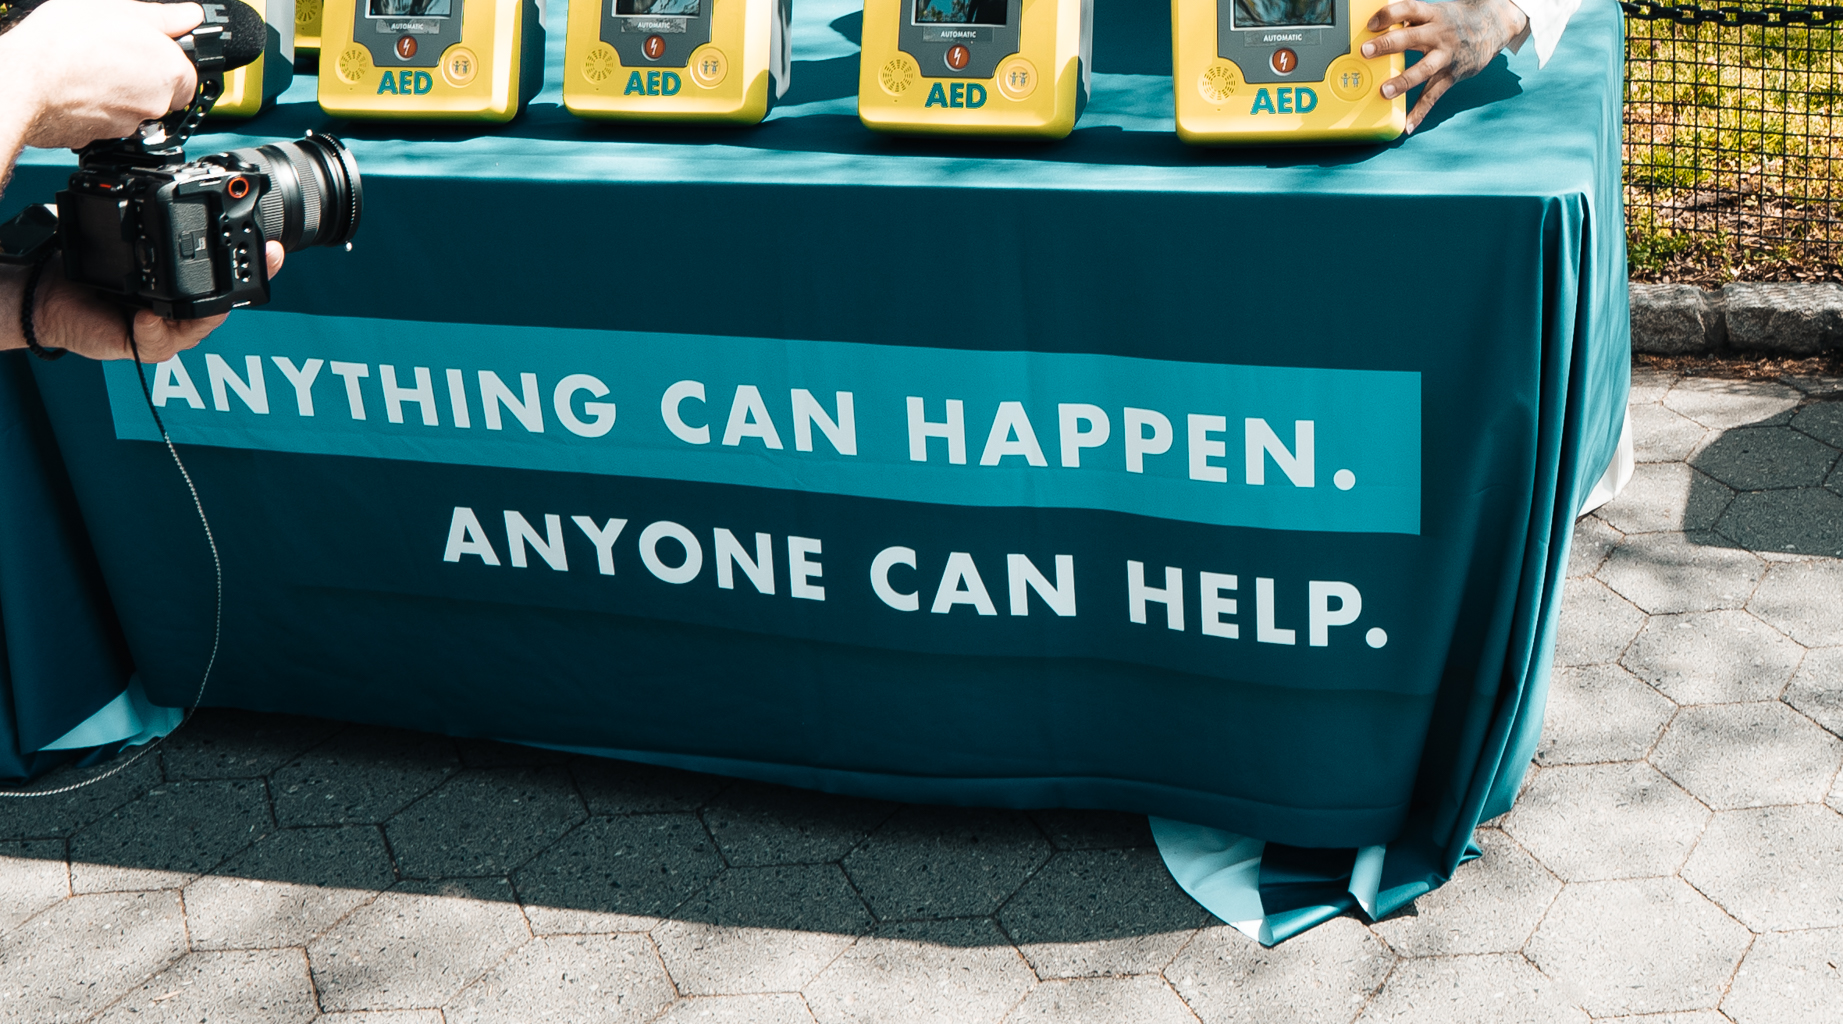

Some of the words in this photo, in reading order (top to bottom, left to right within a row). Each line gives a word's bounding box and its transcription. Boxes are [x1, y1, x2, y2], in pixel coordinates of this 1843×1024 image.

[391, 22, 424, 30] AUTOMATIC
[637, 21, 671, 29] AUTOMATIC
[940, 30, 977, 38] AUTOMATIC
[1263, 33, 1303, 42] AUTOMATIC
[377, 70, 433, 95] AED
[624, 70, 682, 96] AED
[925, 82, 988, 109] AED
[1250, 87, 1318, 115] AED
[151, 353, 617, 438] ANYTHING
[660, 380, 858, 456] CAN
[906, 396, 1356, 491] HAPPEN.
[443, 506, 826, 601] ANYONE
[870, 545, 1077, 617] CAN
[1127, 559, 1388, 649] HELP.
